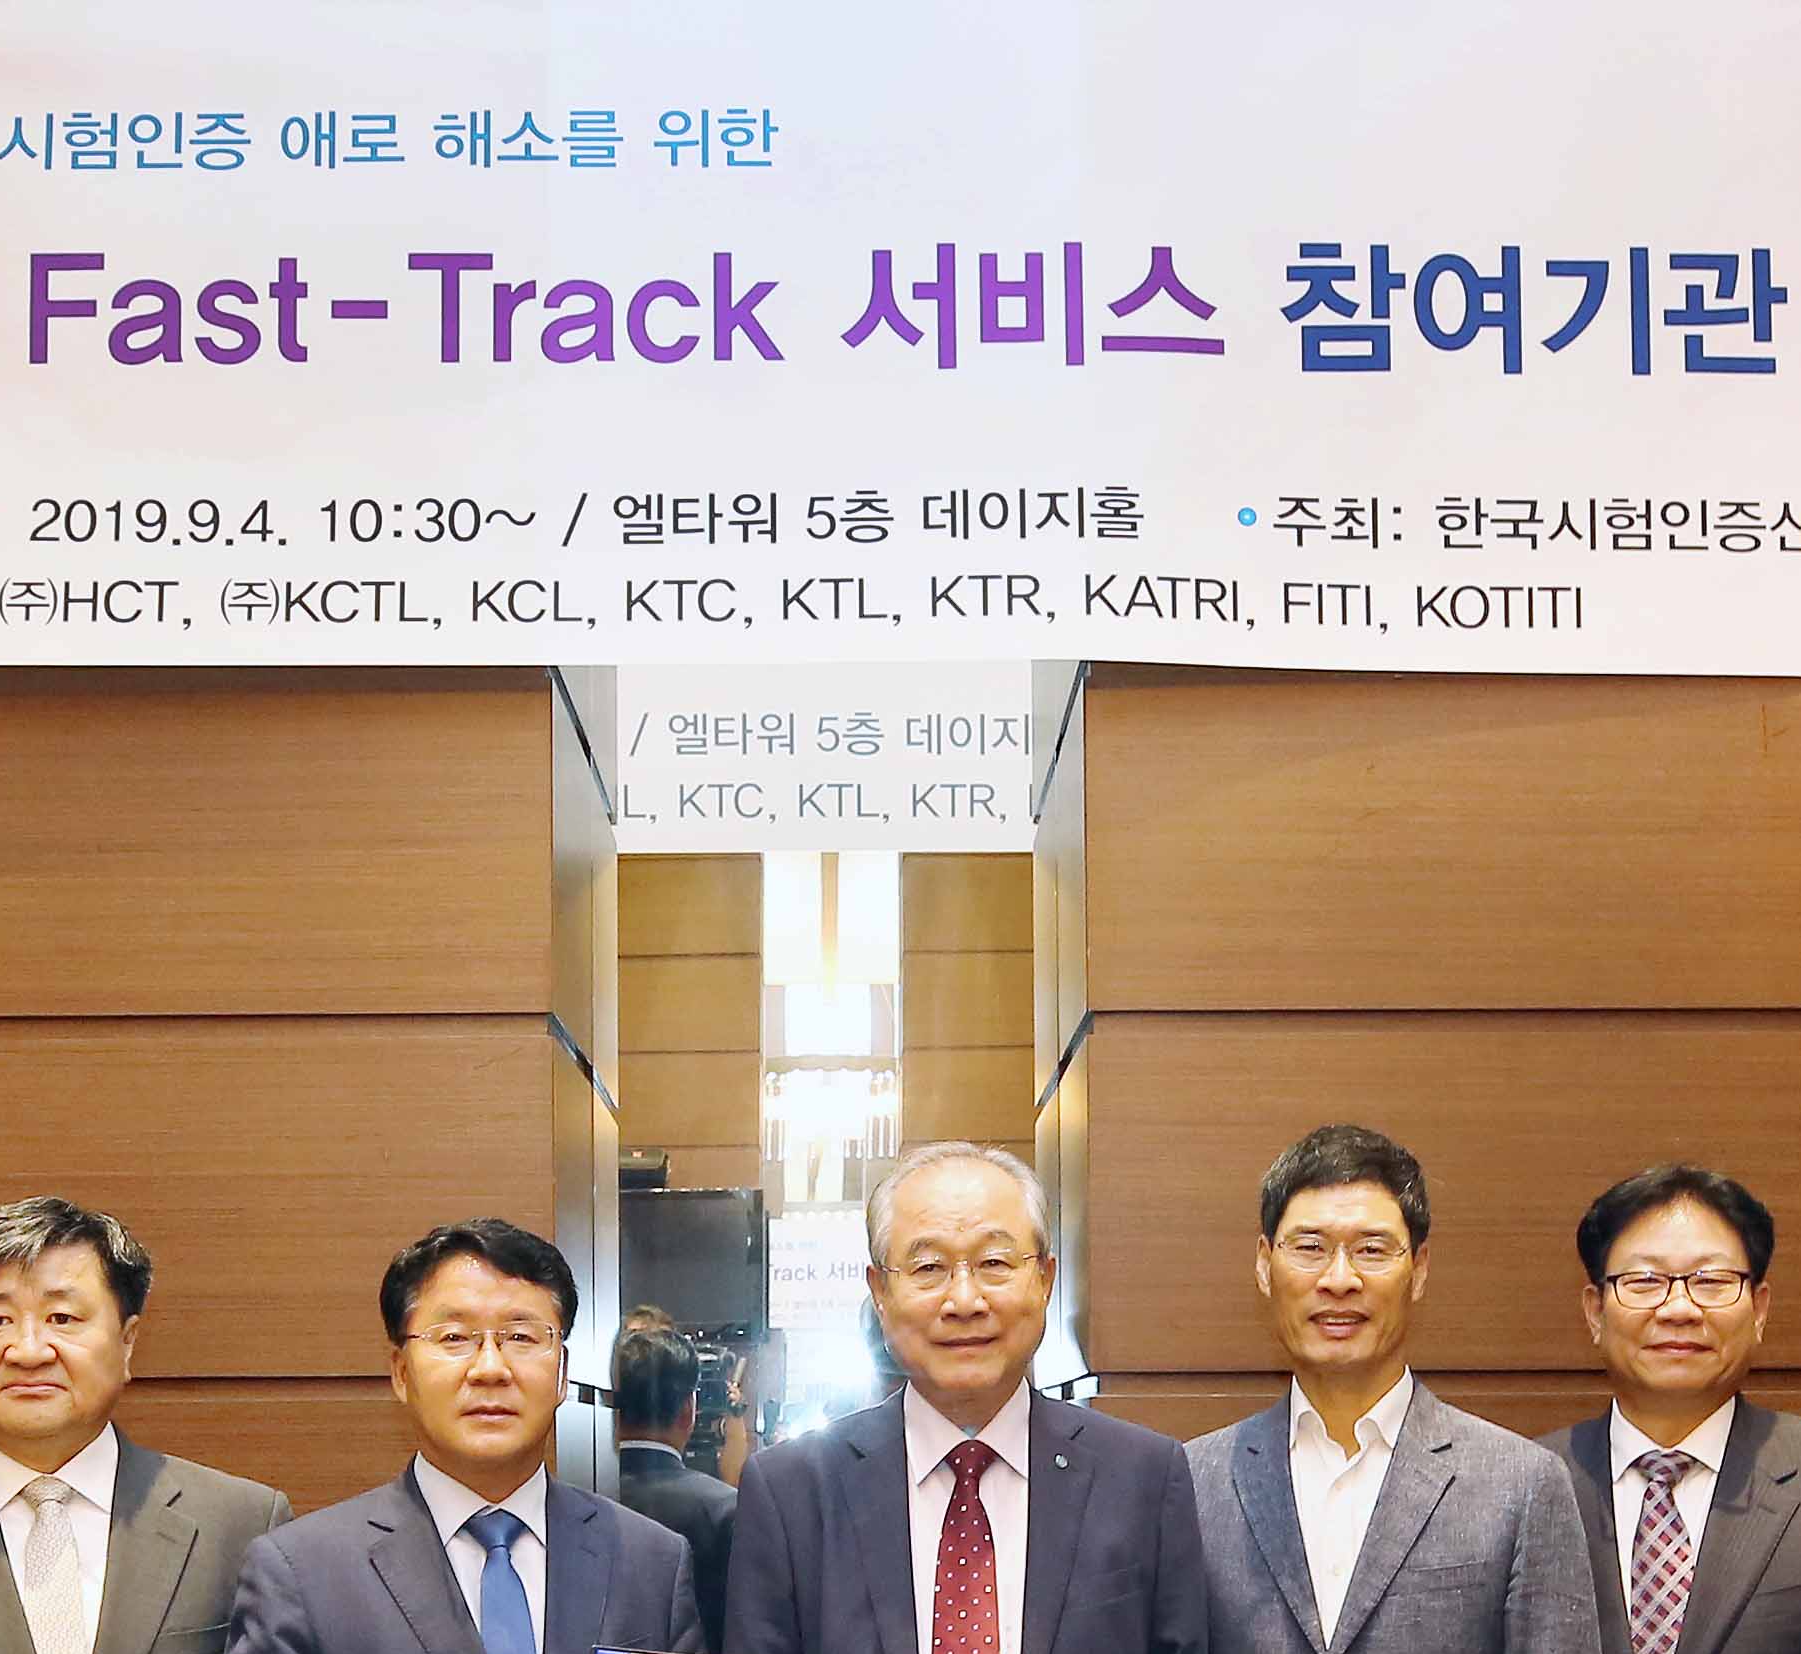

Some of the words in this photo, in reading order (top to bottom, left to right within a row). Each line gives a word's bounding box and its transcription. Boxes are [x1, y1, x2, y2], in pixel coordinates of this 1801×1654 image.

[281, 111, 405, 169] 애로
[433, 110, 623, 168] 해소를
[654, 109, 779, 168] 위한
[840, 242, 1225, 369] 서비스
[1280, 243, 1788, 376] 참여기관
[30, 499, 287, 546] 2019.9.4.
[613, 492, 777, 544] 엘타워
[807, 490, 894, 543] 5층
[923, 486, 1144, 540] 데이지홀
[1273, 497, 1402, 549] 주최:
[472, 580, 596, 629] KCL,
[627, 579, 752, 629] KTC,
[783, 578, 901, 626] KTL,
[931, 575, 1055, 623] KTR,
[1085, 574, 1254, 631] KATRI,
[1283, 582, 1387, 634] FITI,
[1417, 585, 1581, 629] KOTITI
[669, 713, 794, 755] 엘타워
[818, 713, 884, 755] 5층
[907, 714, 1029, 755] 데이지
[680, 783, 775, 823] KTC,
[799, 784, 889, 823] KTL,
[913, 784, 1006, 822] KTR,
